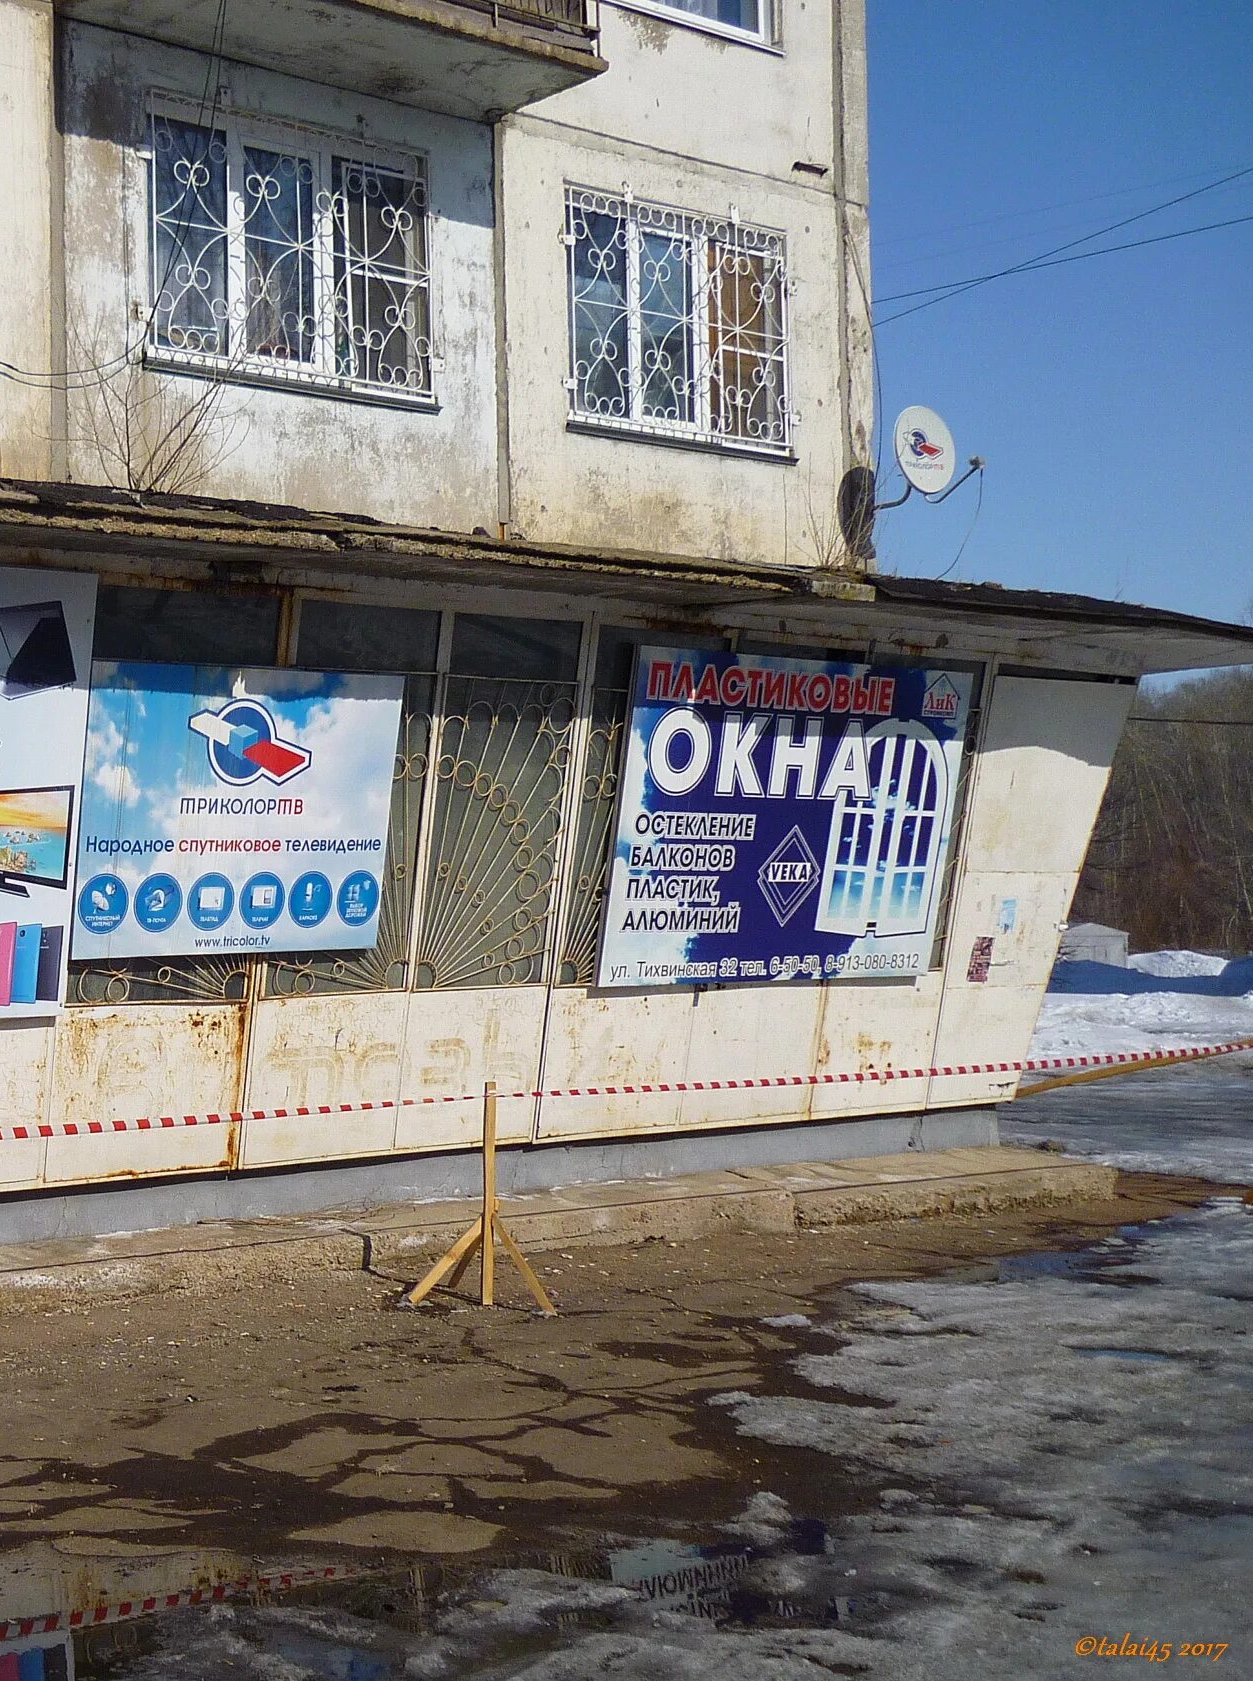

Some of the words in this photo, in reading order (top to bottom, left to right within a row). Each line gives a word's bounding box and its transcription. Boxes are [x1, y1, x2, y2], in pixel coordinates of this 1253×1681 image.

[647, 660, 896, 715] ПЛАСТИКОВЫЕ
[649, 705, 872, 800] ОКНА
[635, 812, 756, 840] ОСТЕКЛЕНИЕ
[86, 836, 175, 856] Народное
[179, 837, 281, 855] спутниковое
[285, 837, 381, 854] телевидение
[630, 844, 736, 871] БАЛКОНОВ
[768, 863, 810, 883] VEKA
[626, 876, 720, 902] ПЛАСТИК,
[622, 903, 740, 932] АЛЮМИНИЙ
[194, 934, 271, 948] www.tricolor.tv
[610, 964, 630, 982] ул.
[636, 960, 717, 978] Тихвинская
[719, 958, 736, 976] 32
[739, 959, 766, 977] тел.
[770, 955, 822, 976] 6-50-50,
[825, 953, 919, 973] 8-913-080-8312
